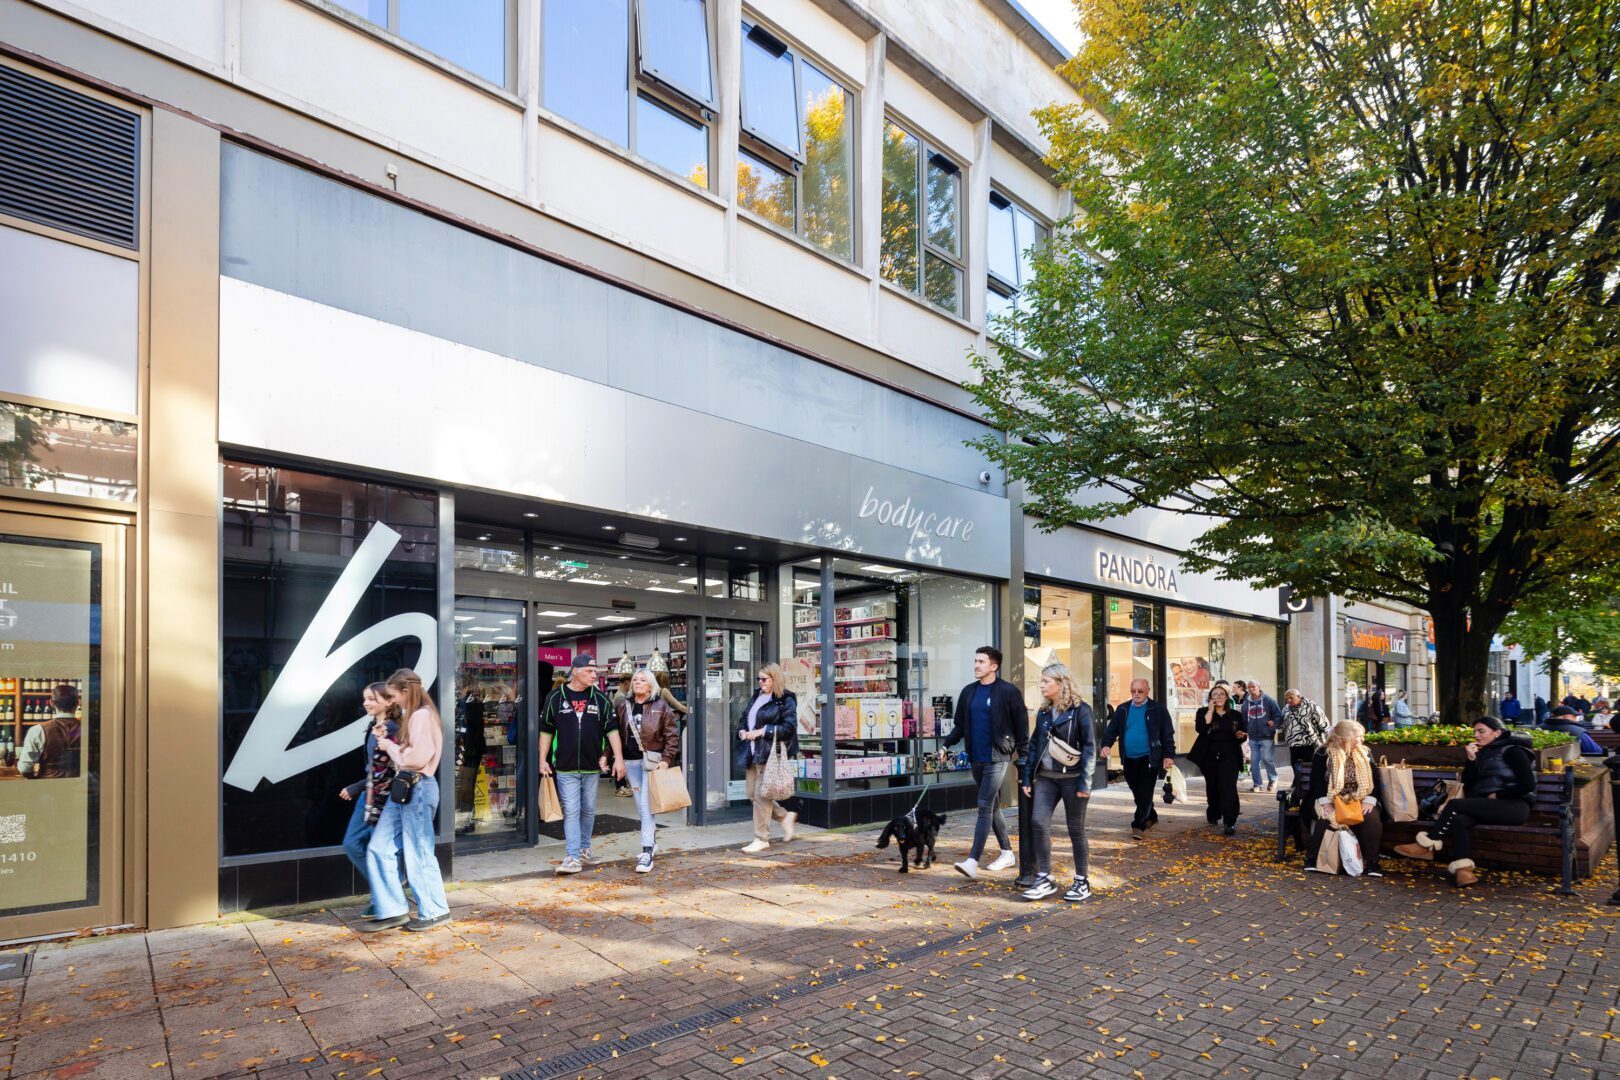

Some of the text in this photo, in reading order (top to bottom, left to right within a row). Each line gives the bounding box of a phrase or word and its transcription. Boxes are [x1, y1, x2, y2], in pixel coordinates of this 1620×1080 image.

[859, 486, 974, 544] bodycare
[1099, 551, 1178, 592] PANDORA
[0, 583, 18, 594] IL
[1351, 626, 1406, 656] Sainsbury's Local
[544, 653, 563, 661] Men's
[789, 675, 807, 685] STYLE
